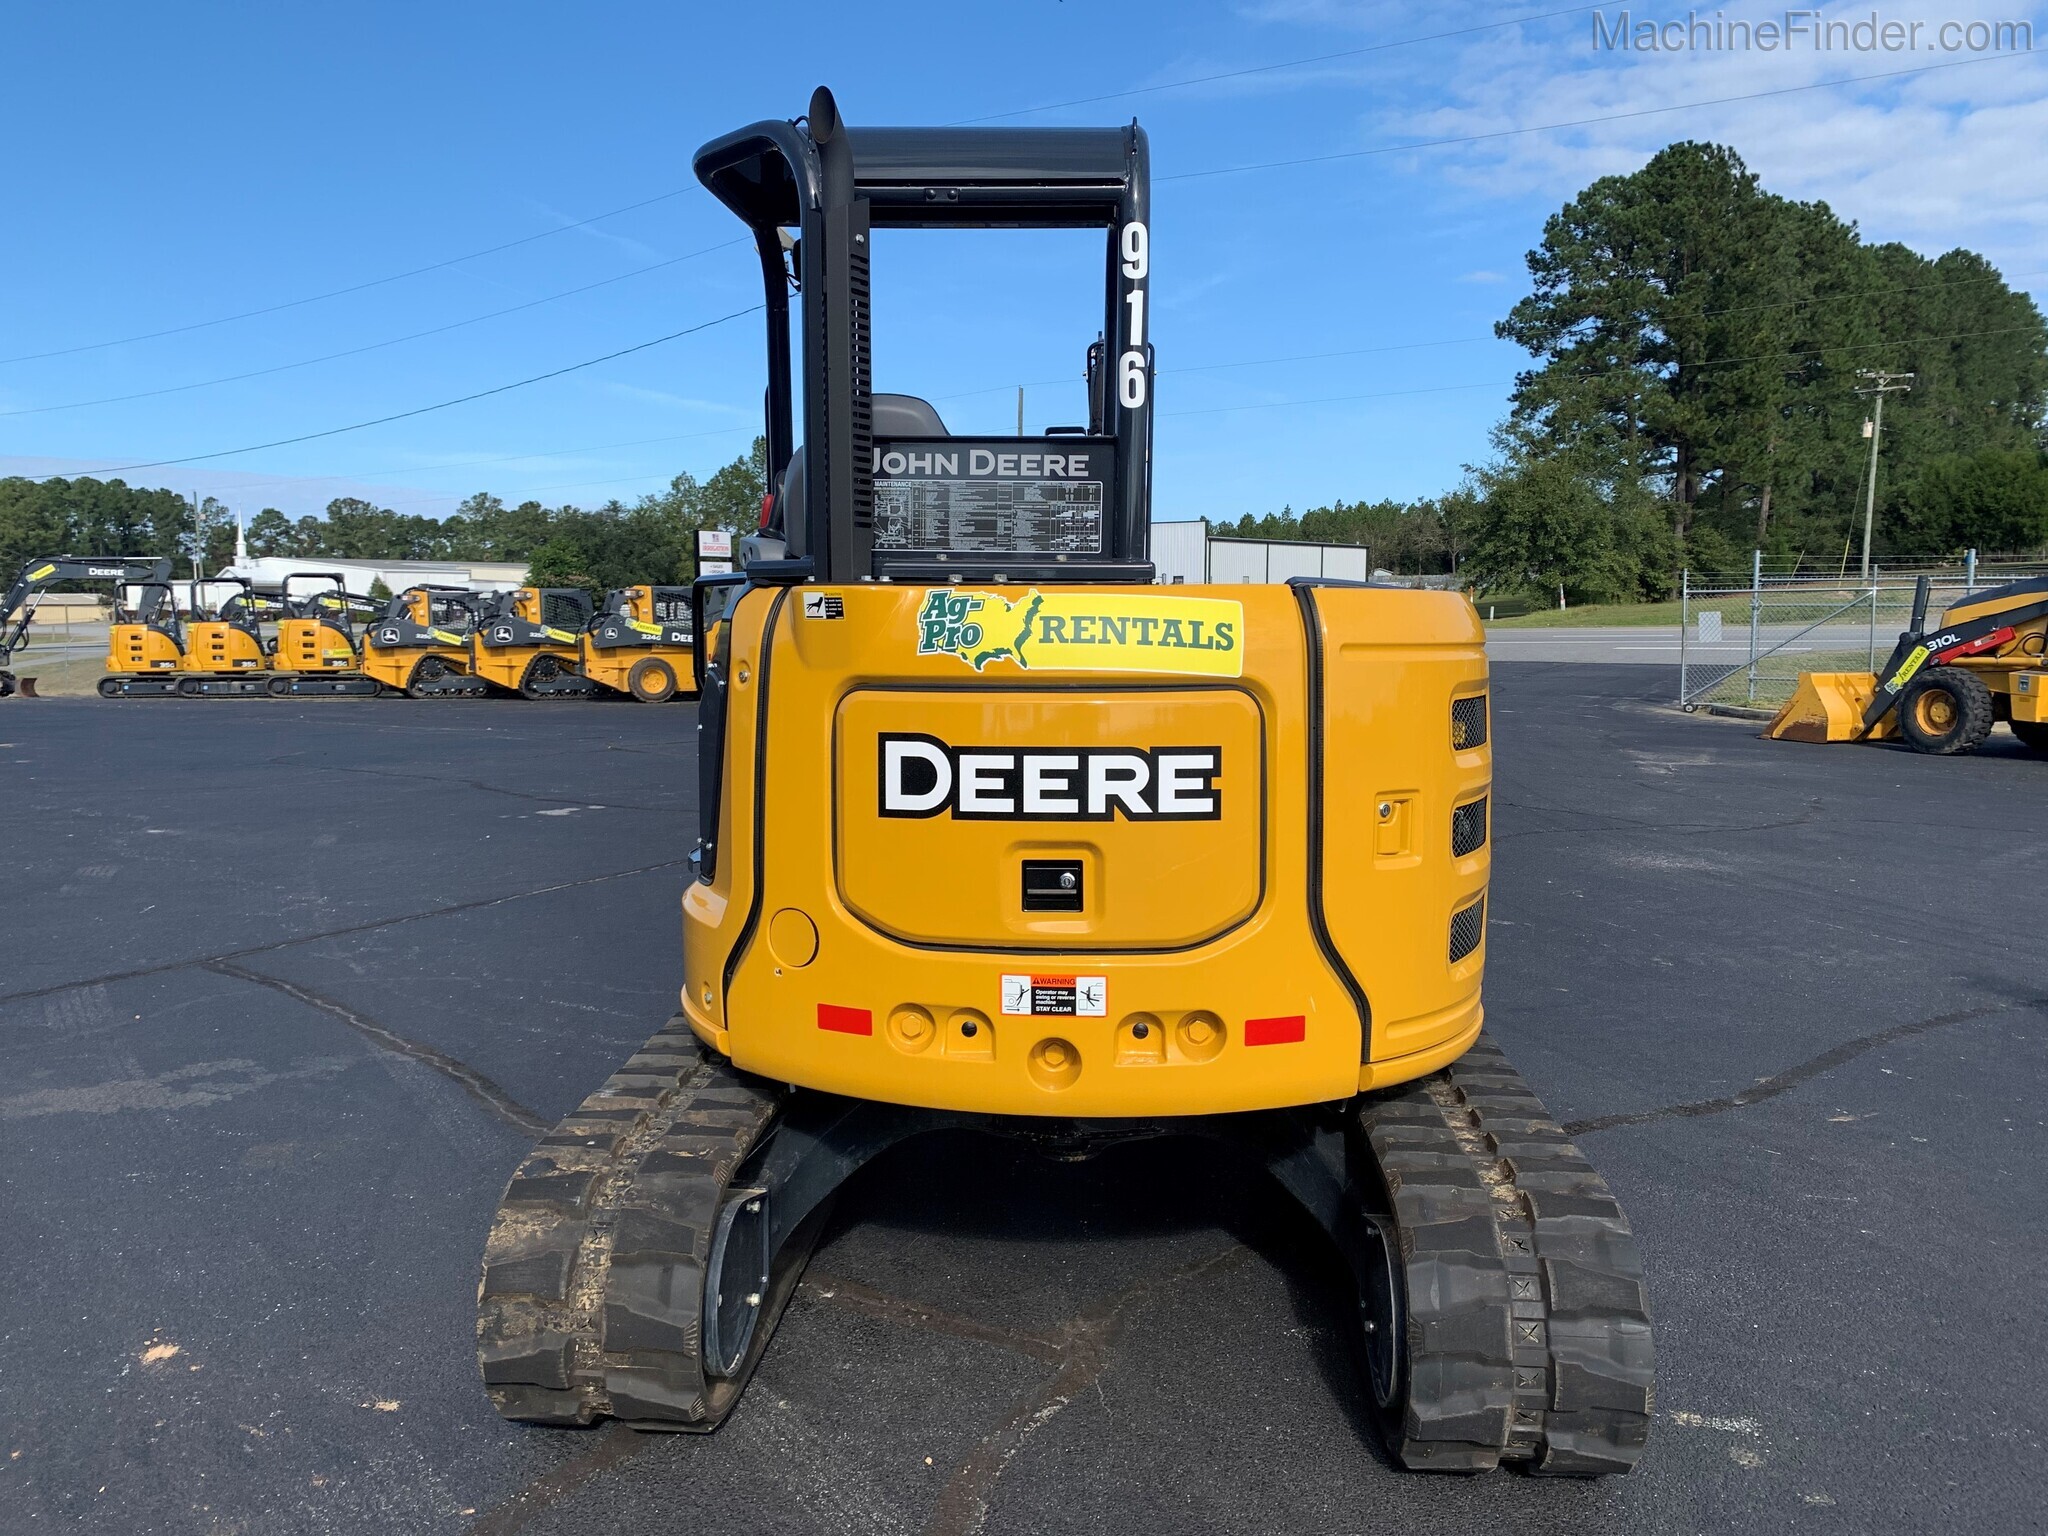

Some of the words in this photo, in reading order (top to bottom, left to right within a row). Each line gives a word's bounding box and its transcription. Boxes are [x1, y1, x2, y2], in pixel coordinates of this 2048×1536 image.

[1119, 221, 1148, 409] 916
[873, 448, 959, 475] JOHN
[969, 449, 1089, 477] DEERE
[88, 567, 125, 576] DEERE
[923, 589, 984, 622] Ag-
[671, 632, 693, 642] DEE
[919, 621, 983, 653] Pro
[1038, 615, 1235, 652] RENTALS
[1927, 634, 1961, 651] 310L
[1903, 649, 1926, 677] RENTALS
[884, 740, 1214, 814] DEERE
